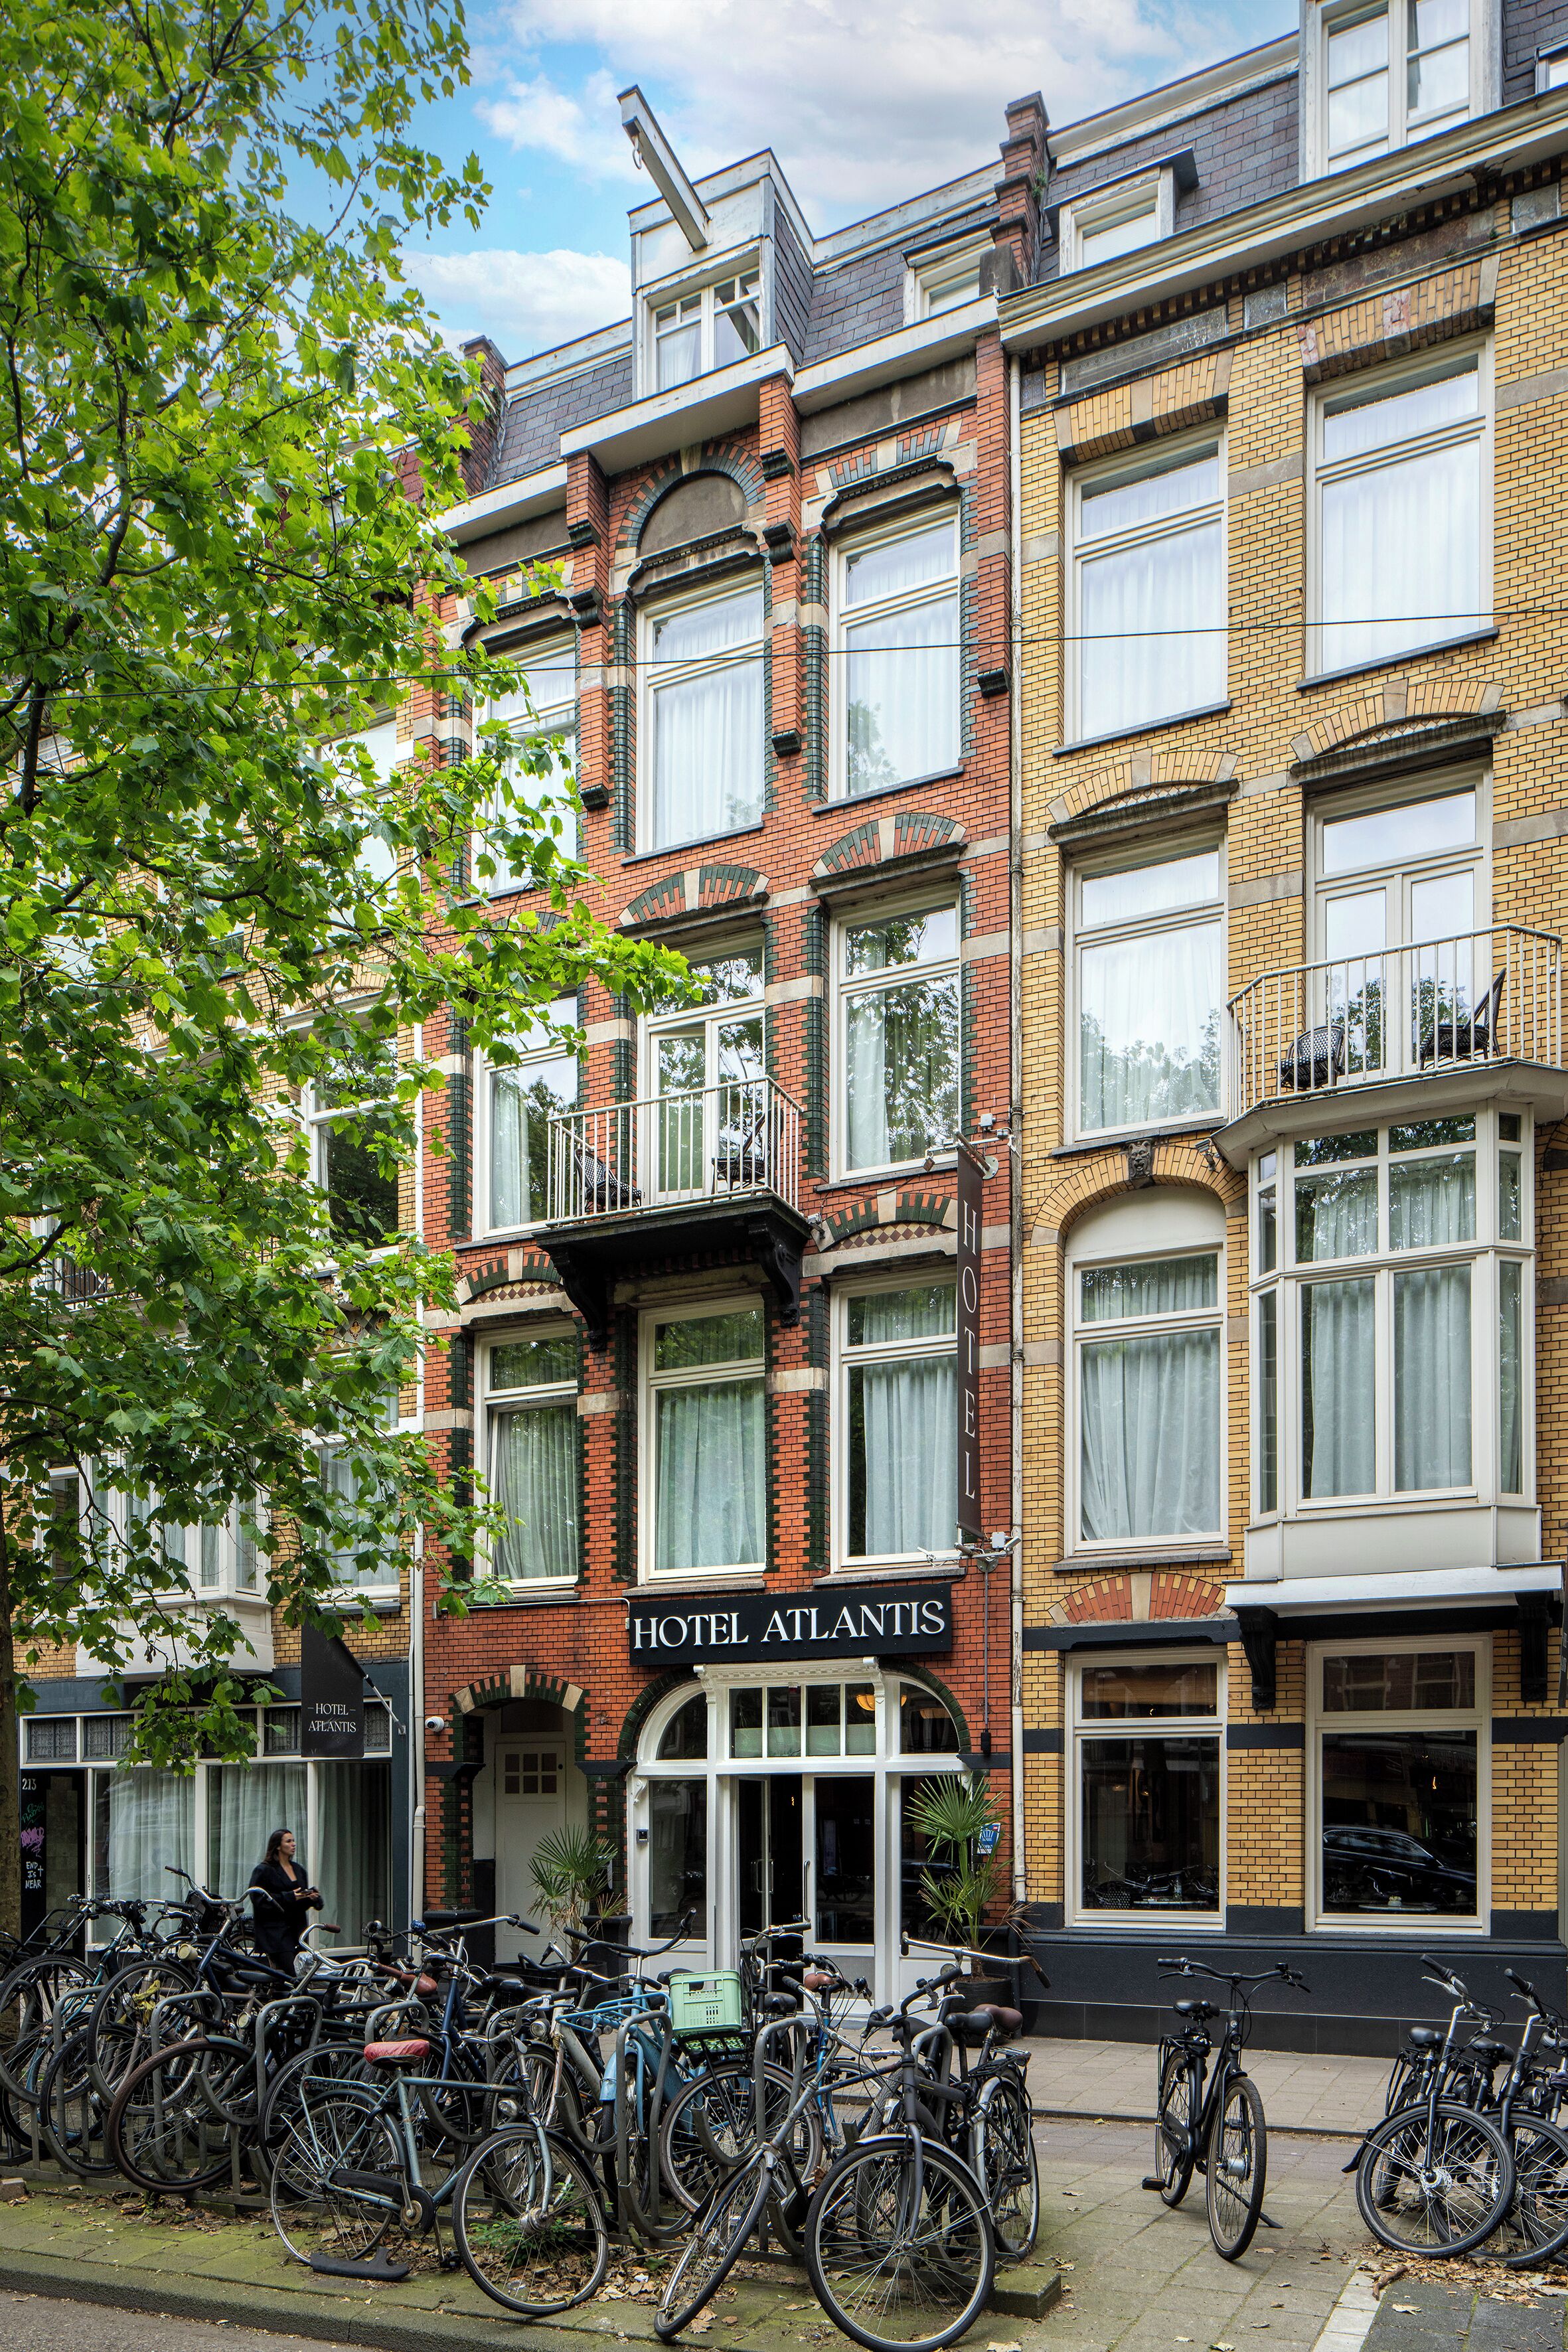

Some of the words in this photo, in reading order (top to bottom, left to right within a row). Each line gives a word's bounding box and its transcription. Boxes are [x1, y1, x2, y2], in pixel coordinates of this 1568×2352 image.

[963, 1199, 977, 1500] HOTEL
[633, 1612, 749, 1649] HOTEL
[760, 1600, 945, 1643] ATLANTIS
[315, 1703, 349, 1715] HOTEL
[308, 1720, 356, 1733] ATLANTIS
[22, 1778, 37, 1790] 213
[26, 1861, 39, 1870] END
[25, 1879, 42, 1889] NEAR
